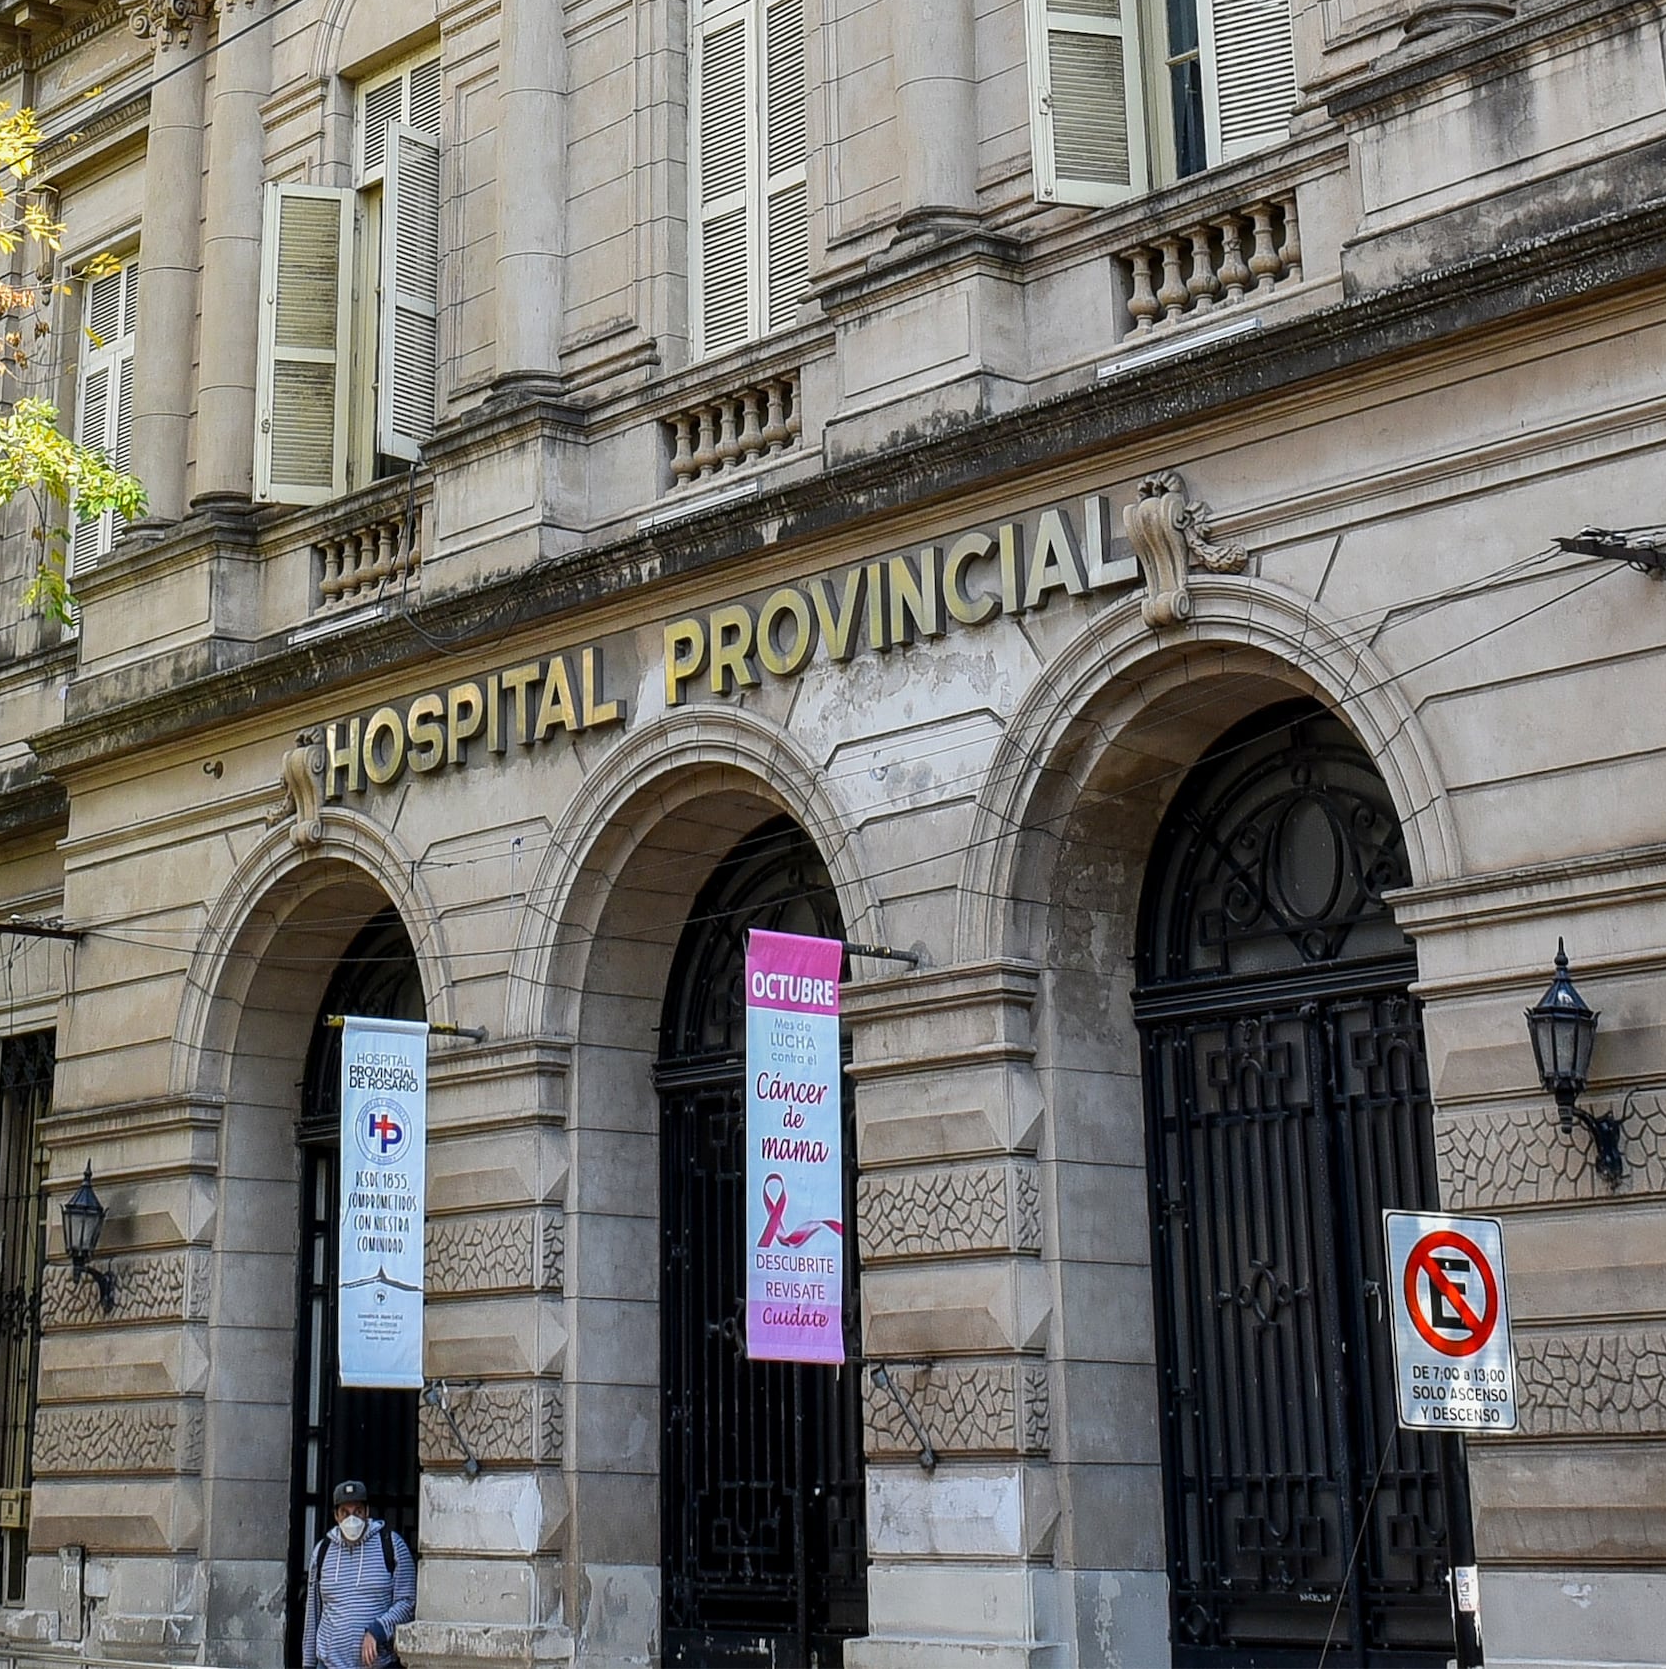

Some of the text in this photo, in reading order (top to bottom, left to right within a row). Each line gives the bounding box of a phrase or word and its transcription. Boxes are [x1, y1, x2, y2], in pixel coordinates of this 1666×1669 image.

[325, 494, 1139, 801] HOSPITAL PROVINCIAL
[751, 970, 834, 1007] OCTUBRE
[774, 1018, 812, 1032] Mes de
[770, 1032, 817, 1051] LUCHA
[357, 1053, 411, 1068] HOSPITAL
[771, 1051, 817, 1065] contra el
[349, 1064, 418, 1081] PROVINCIAL
[349, 1077, 419, 1092] DE ROSARIO
[756, 1071, 828, 1105] Cáncer
[783, 1104, 805, 1129] de
[761, 1136, 829, 1163] mama
[355, 1170, 379, 1188] DESDE
[348, 1192, 417, 1211] COMPROMETIDOS
[354, 1214, 410, 1235] CON NUESTRA
[756, 1254, 834, 1274] DESCUBRITE
[765, 1281, 825, 1300] REVISATE
[762, 1304, 829, 1328] Cuidate
[1413, 1366, 1430, 1380] DE
[1413, 1385, 1508, 1402] SOLO ASCENSO
[1421, 1405, 1500, 1423] Y DESCENSO
